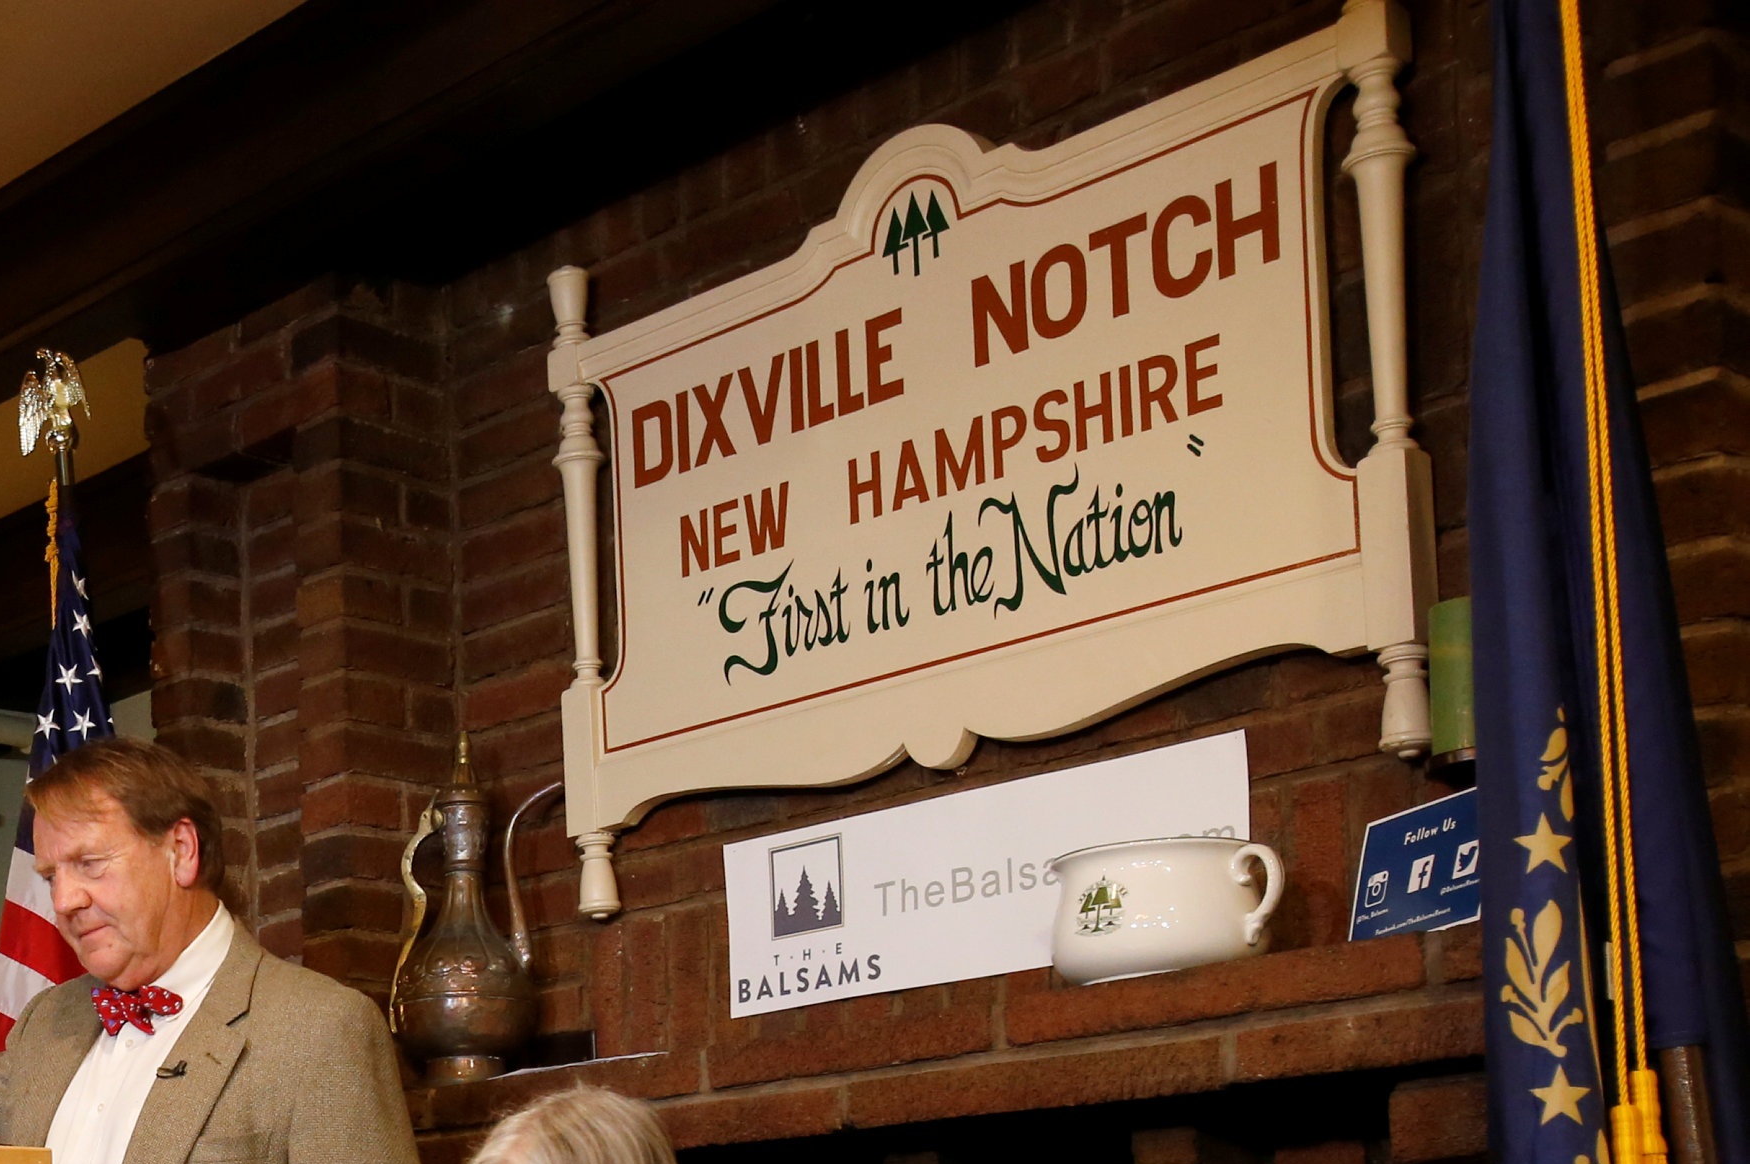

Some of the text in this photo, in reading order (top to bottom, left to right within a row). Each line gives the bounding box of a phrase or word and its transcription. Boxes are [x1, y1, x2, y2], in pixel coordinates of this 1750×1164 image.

[633, 162, 1279, 488] DIXVILLE NOTCH
[681, 335, 1223, 577] NEW HAMPSHIRE
[864, 558, 910, 634] in
[926, 511, 994, 616] the
[1404, 817, 1456, 845] Follow Us
[738, 953, 883, 1004] BALSAMS
